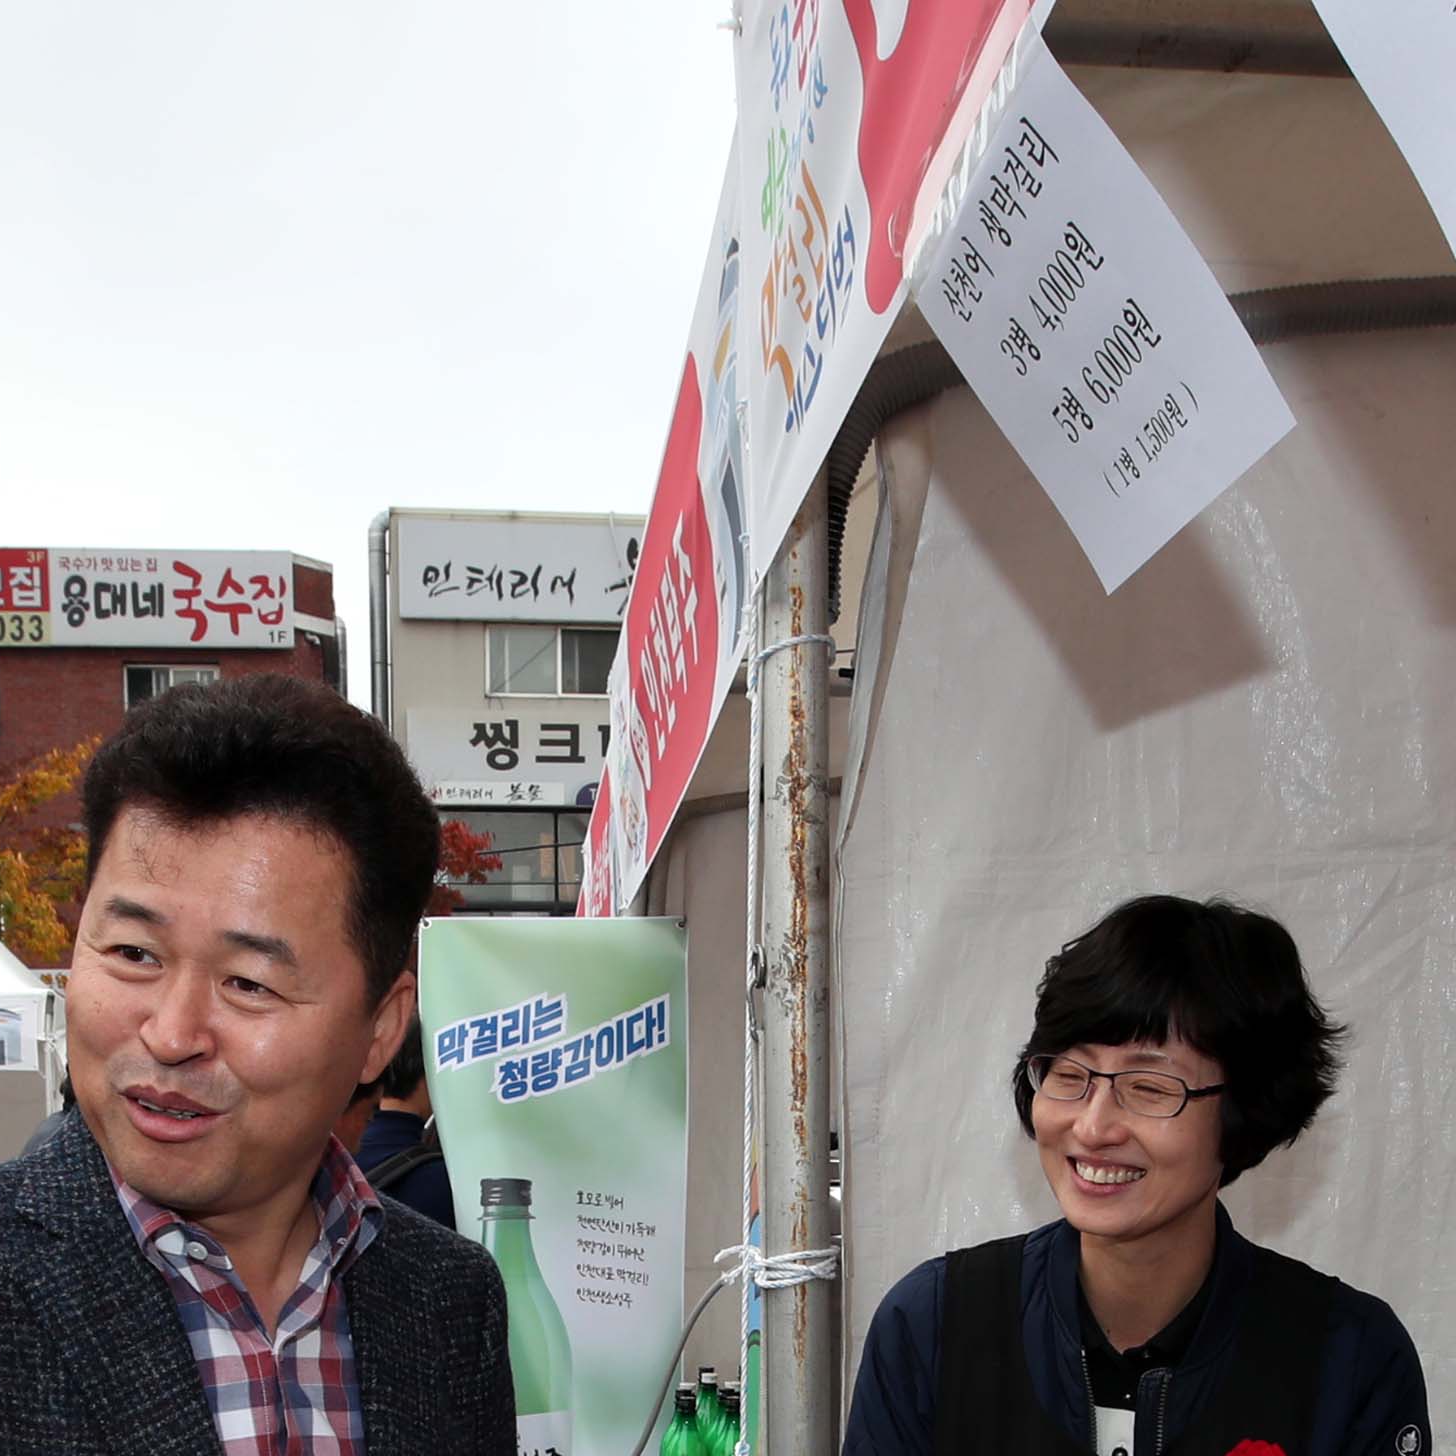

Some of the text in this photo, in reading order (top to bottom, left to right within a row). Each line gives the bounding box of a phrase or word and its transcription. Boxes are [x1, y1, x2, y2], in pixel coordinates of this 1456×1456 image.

[942, 116, 1059, 323] 산천어 생막걸리
[999, 220, 1104, 378] 3병 4,000원
[1050, 298, 1163, 445] 5병 6,000원
[1136, 395, 1189, 466] 1,500원
[26, 551, 44, 563] 3F
[58, 557, 158, 572] 국수가 맛 있는 집
[421, 558, 577, 602] 인테리어
[61, 560, 287, 642] 용대네 국수집
[268, 631, 287, 644] 1F
[469, 718, 608, 771] 씽크
[437, 996, 564, 1066] 막걸리는
[497, 1000, 666, 1101] 청량감이다!
[576, 1263, 615, 1281] 인천대표
